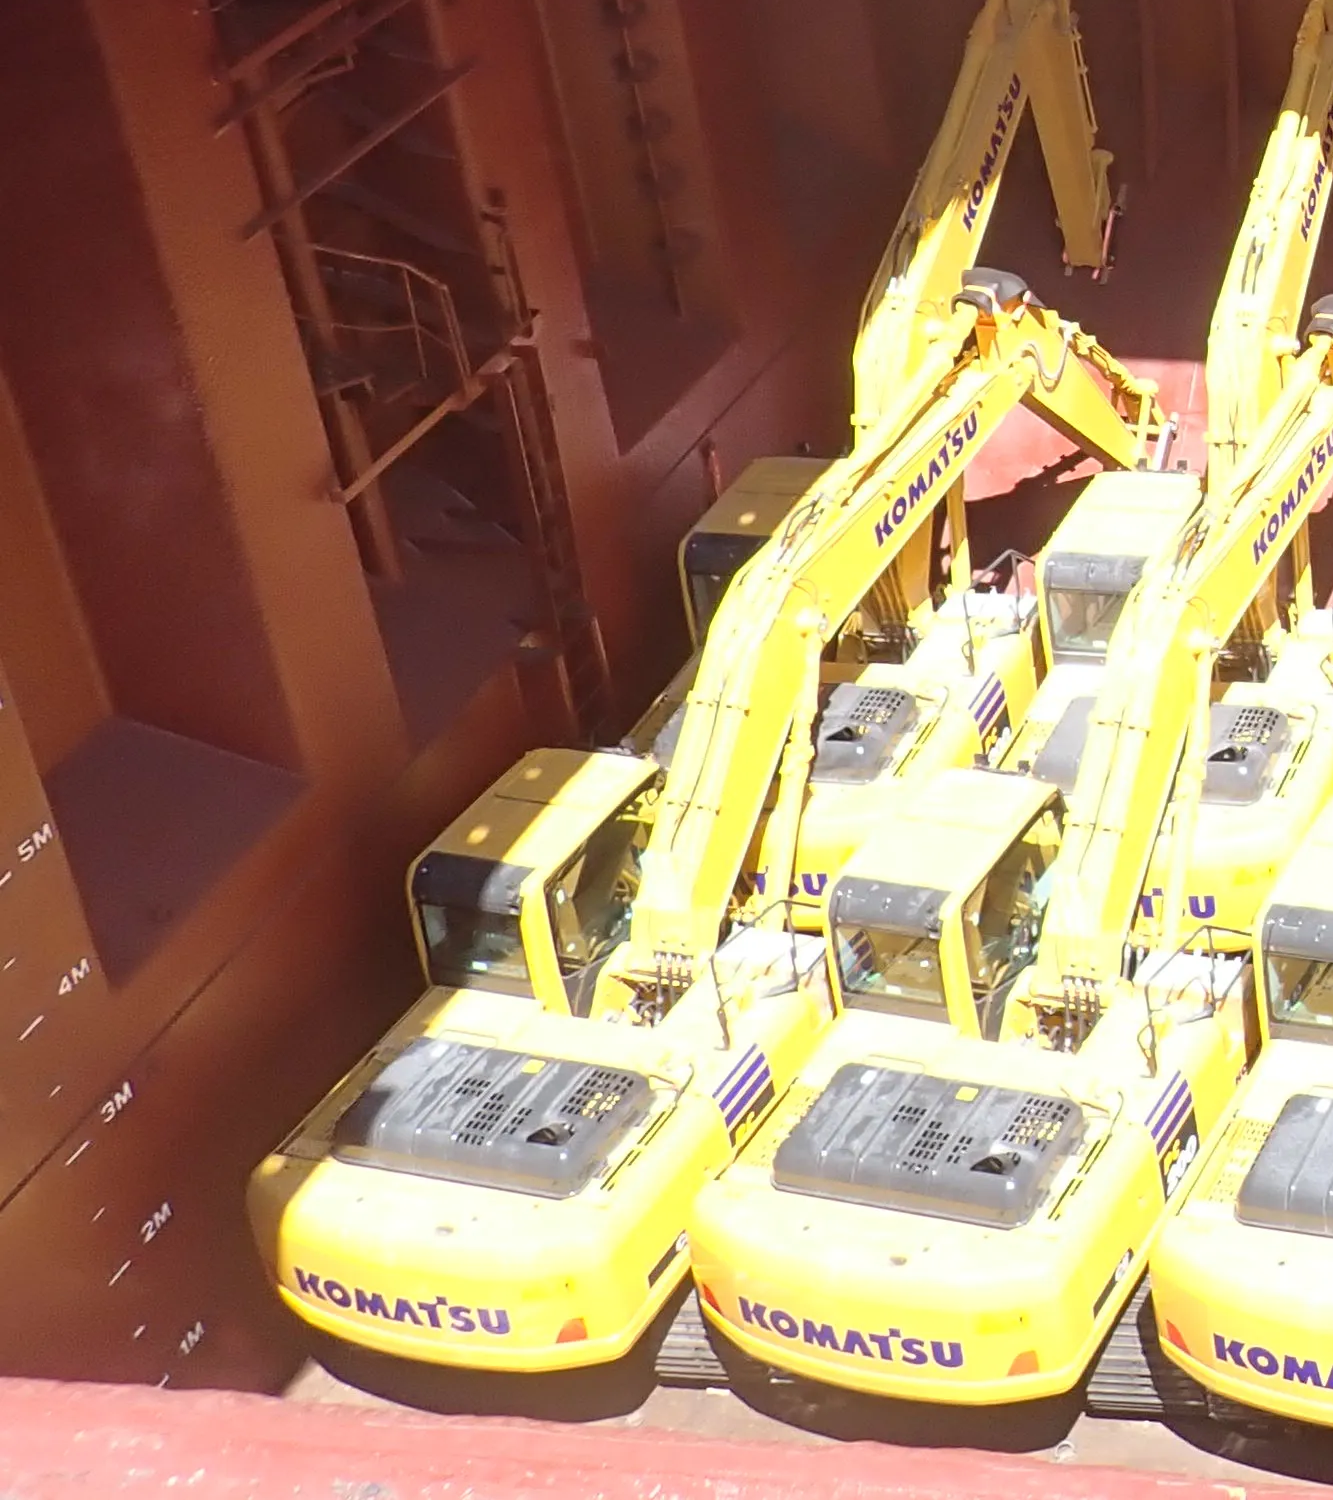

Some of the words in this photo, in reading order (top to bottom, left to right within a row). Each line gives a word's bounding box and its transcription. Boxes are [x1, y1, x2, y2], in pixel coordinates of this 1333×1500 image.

[962, 73, 1021, 233] KOMATSU
[874, 412, 979, 547] KOMATSU
[17, 822, 54, 863] 5M
[58, 956, 92, 996] 4M
[100, 1081, 135, 1124] 3M
[139, 1201, 174, 1245] 2M
[294, 1267, 511, 1336] KOMATSU
[179, 1320, 206, 1357] 1M
[738, 1296, 964, 1368] KOMATSU
